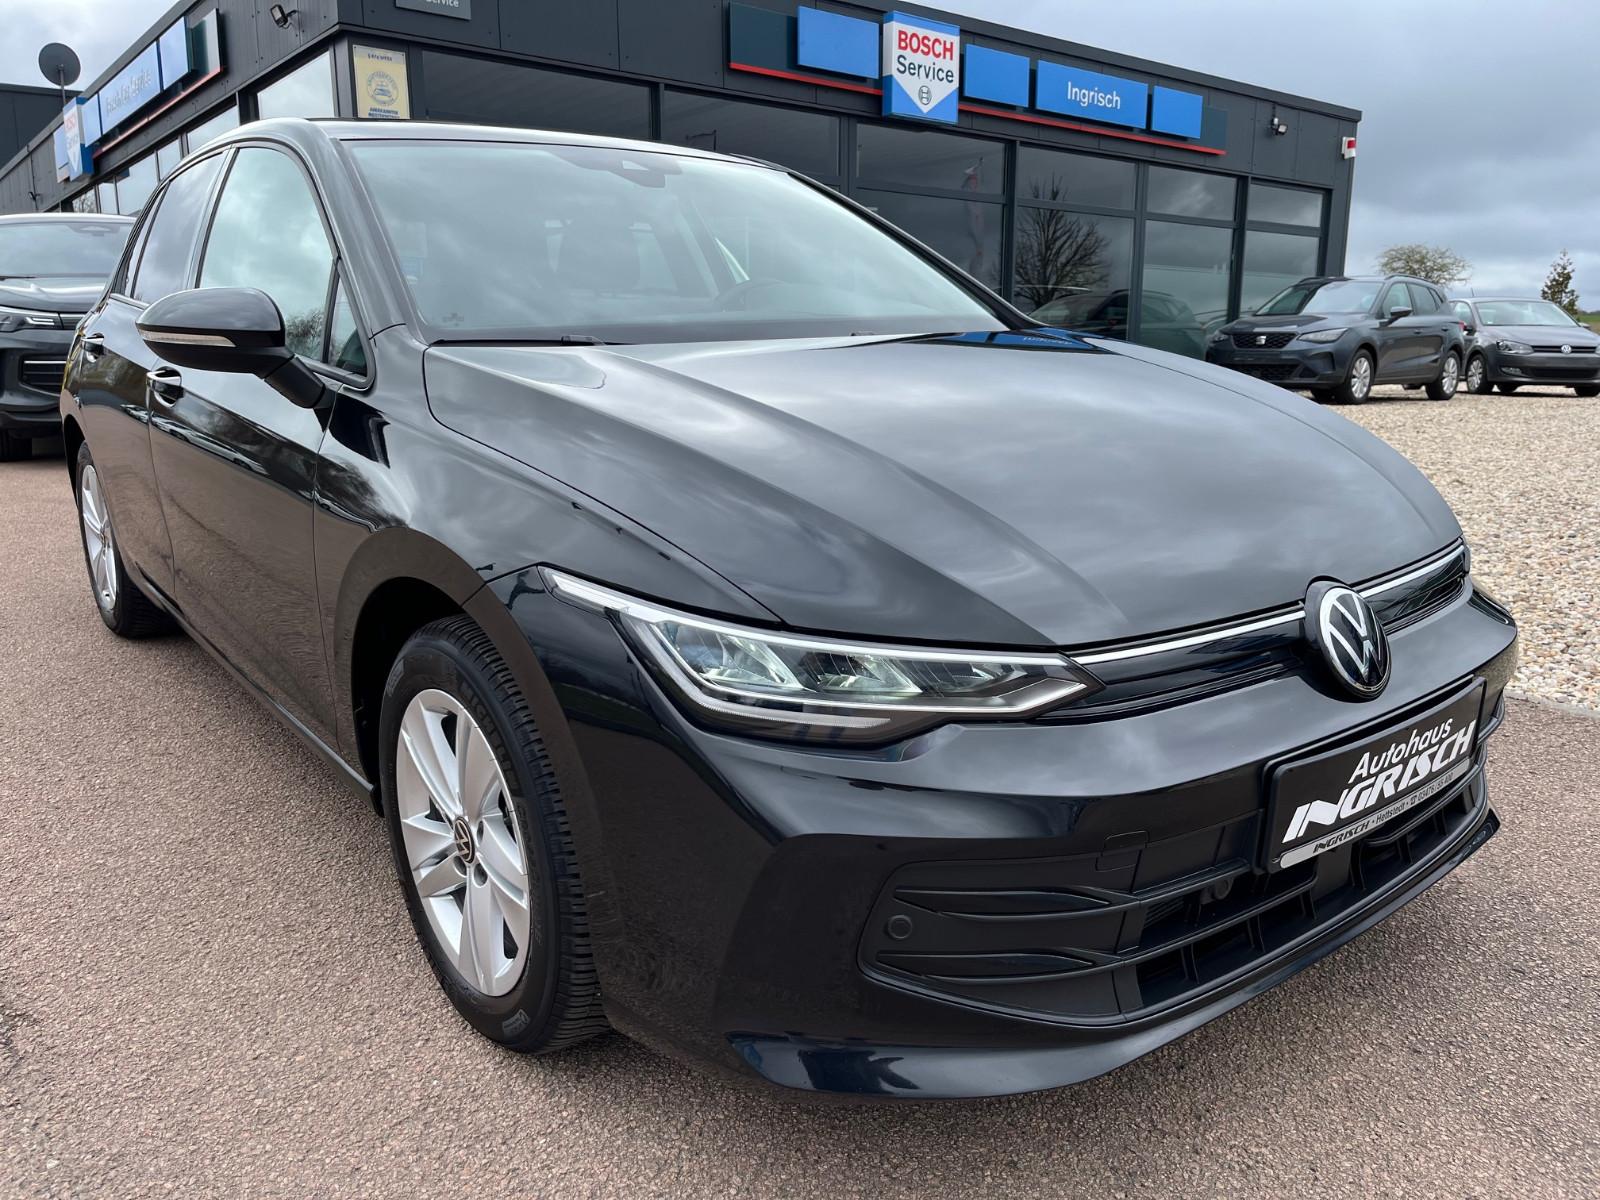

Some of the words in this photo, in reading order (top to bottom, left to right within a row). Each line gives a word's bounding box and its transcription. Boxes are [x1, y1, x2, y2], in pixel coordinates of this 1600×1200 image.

[426, 0, 459, 8] ervice
[898, 30, 954, 61] BOSCH
[896, 54, 954, 83] Service
[1067, 81, 1121, 110] Ingrisch
[1348, 718, 1453, 784] Autohaus
[1282, 720, 1477, 843] INGRISCH
[1312, 819, 1370, 854] INGRISCH
[1376, 802, 1405, 824] Hettstedt
